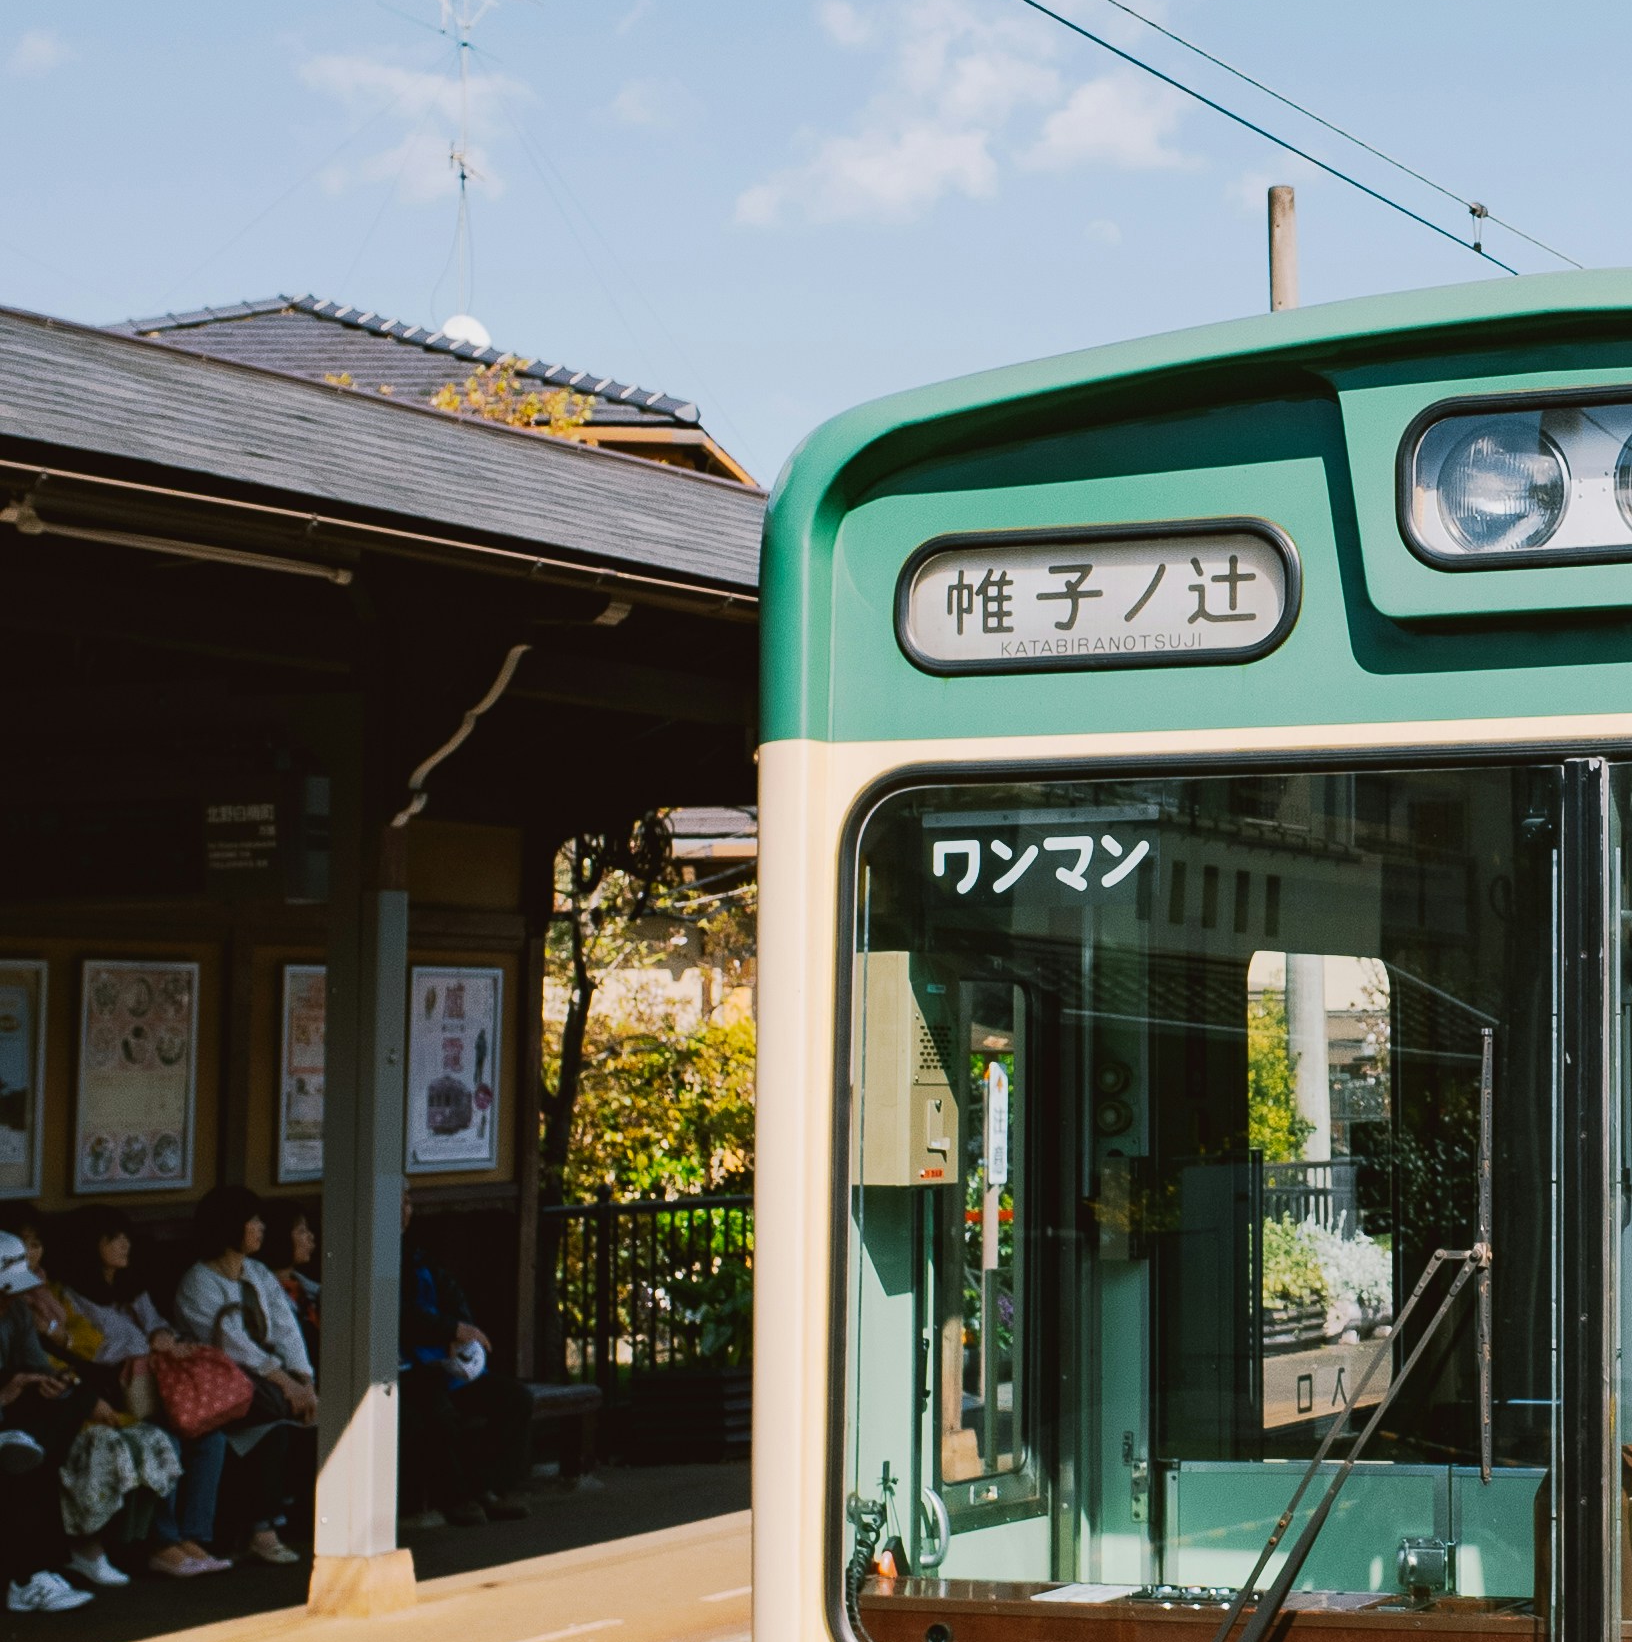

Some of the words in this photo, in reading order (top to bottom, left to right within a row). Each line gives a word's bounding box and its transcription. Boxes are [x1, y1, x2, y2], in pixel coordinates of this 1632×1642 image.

[946, 554, 1257, 636] 帷子ノ辻
[1000, 632, 1203, 657] KATABIRANOTSUJI
[931, 833, 1151, 896] ワンマン
